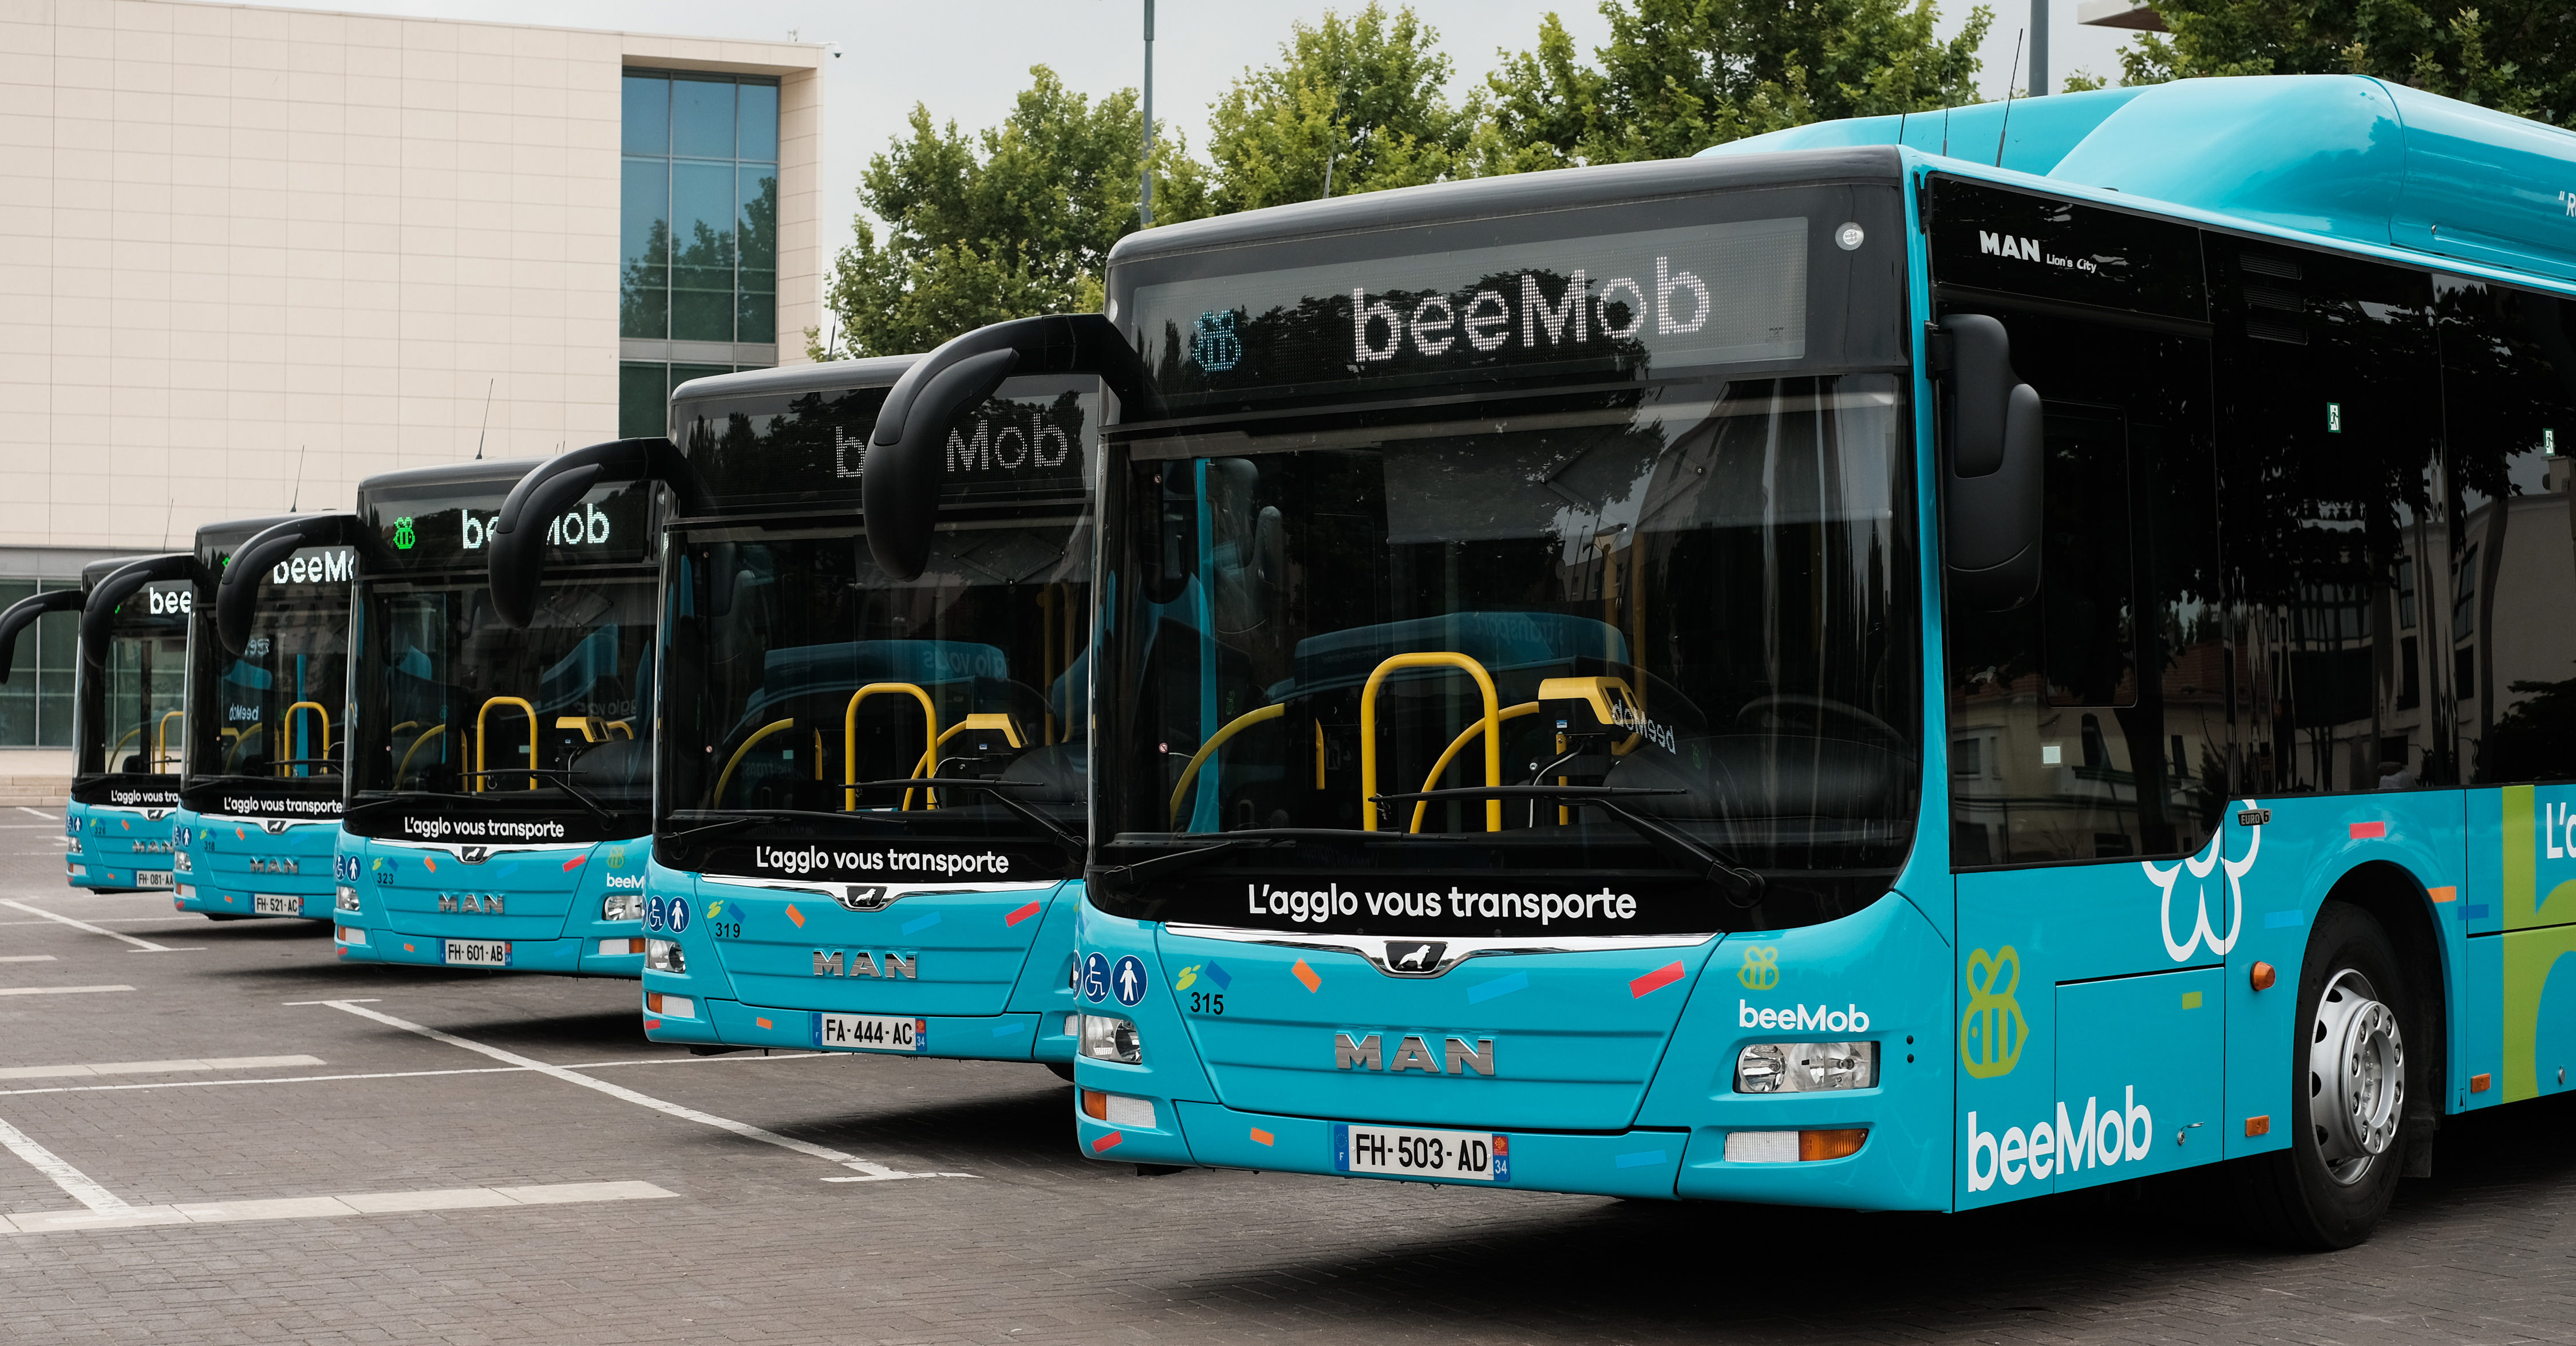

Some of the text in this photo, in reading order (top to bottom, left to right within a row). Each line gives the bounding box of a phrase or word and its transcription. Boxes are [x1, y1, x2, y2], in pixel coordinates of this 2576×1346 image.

[1980, 230, 2097, 274] MAN Lion's City
[1353, 256, 1710, 363] beeMob
[836, 413, 1068, 478] bMob
[111, 790, 141, 804] L'agglo
[143, 793, 163, 802] vous
[224, 796, 343, 815] L'agglo vous transporte
[405, 816, 564, 840] L'agglo vous transporte
[2241, 810, 2269, 825] EURO 6
[133, 839, 174, 853] MAN
[204, 841, 215, 851] 318
[250, 856, 298, 874] MAN
[756, 845, 1009, 877] L'agglo vous transporte
[139, 873, 173, 885] FH-081-AA
[377, 873, 394, 885] 323
[256, 897, 298, 912] FH-521-AC
[438, 893, 504, 914] MAN
[1248, 882, 1637, 925] L'agglo vous transporte
[715, 922, 741, 938] 319
[448, 944, 503, 962] FH-601-AB
[505, 954, 511, 962] 34
[813, 949, 918, 980] MAN
[1190, 992, 1224, 1015] 315
[1739, 999, 1870, 1033] beeMob
[826, 1019, 912, 1045] FA-444-AC
[916, 1036, 925, 1047] 34
[1334, 1032, 1495, 1076] MAN
[1967, 1084, 2153, 1193] beeMob
[1340, 1152, 1344, 1161] F
[1356, 1134, 1488, 1172] FH-503-AD
[1495, 1159, 1507, 1174] 34
